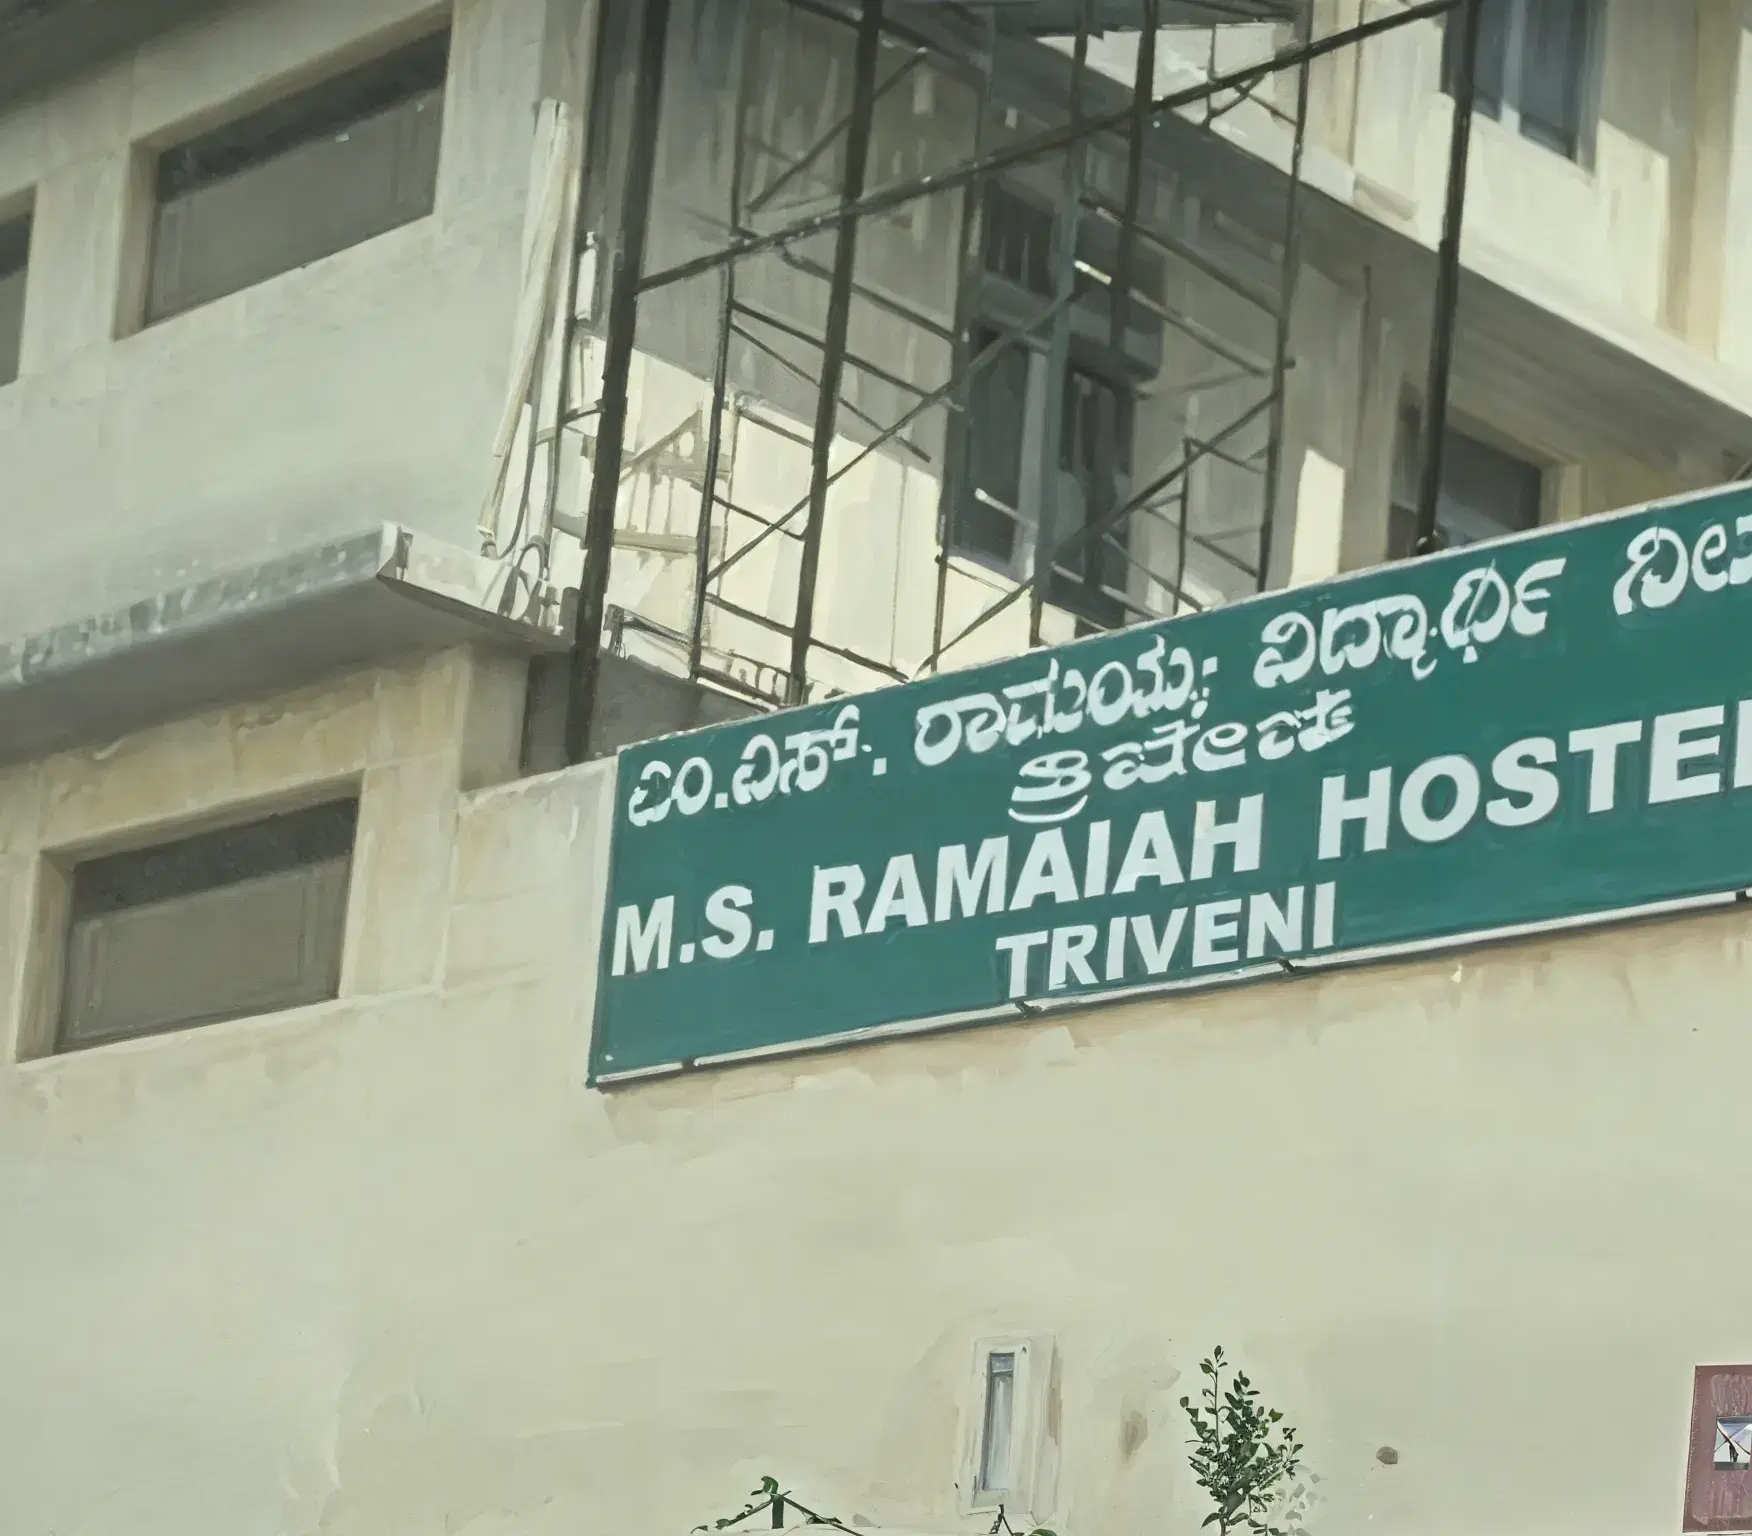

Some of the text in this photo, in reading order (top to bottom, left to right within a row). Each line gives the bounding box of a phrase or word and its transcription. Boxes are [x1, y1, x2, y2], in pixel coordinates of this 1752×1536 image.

[611, 886, 775, 979] M.S.
[807, 792, 1265, 945] RAMAIAH
[994, 880, 1337, 1000] TRIVENI
